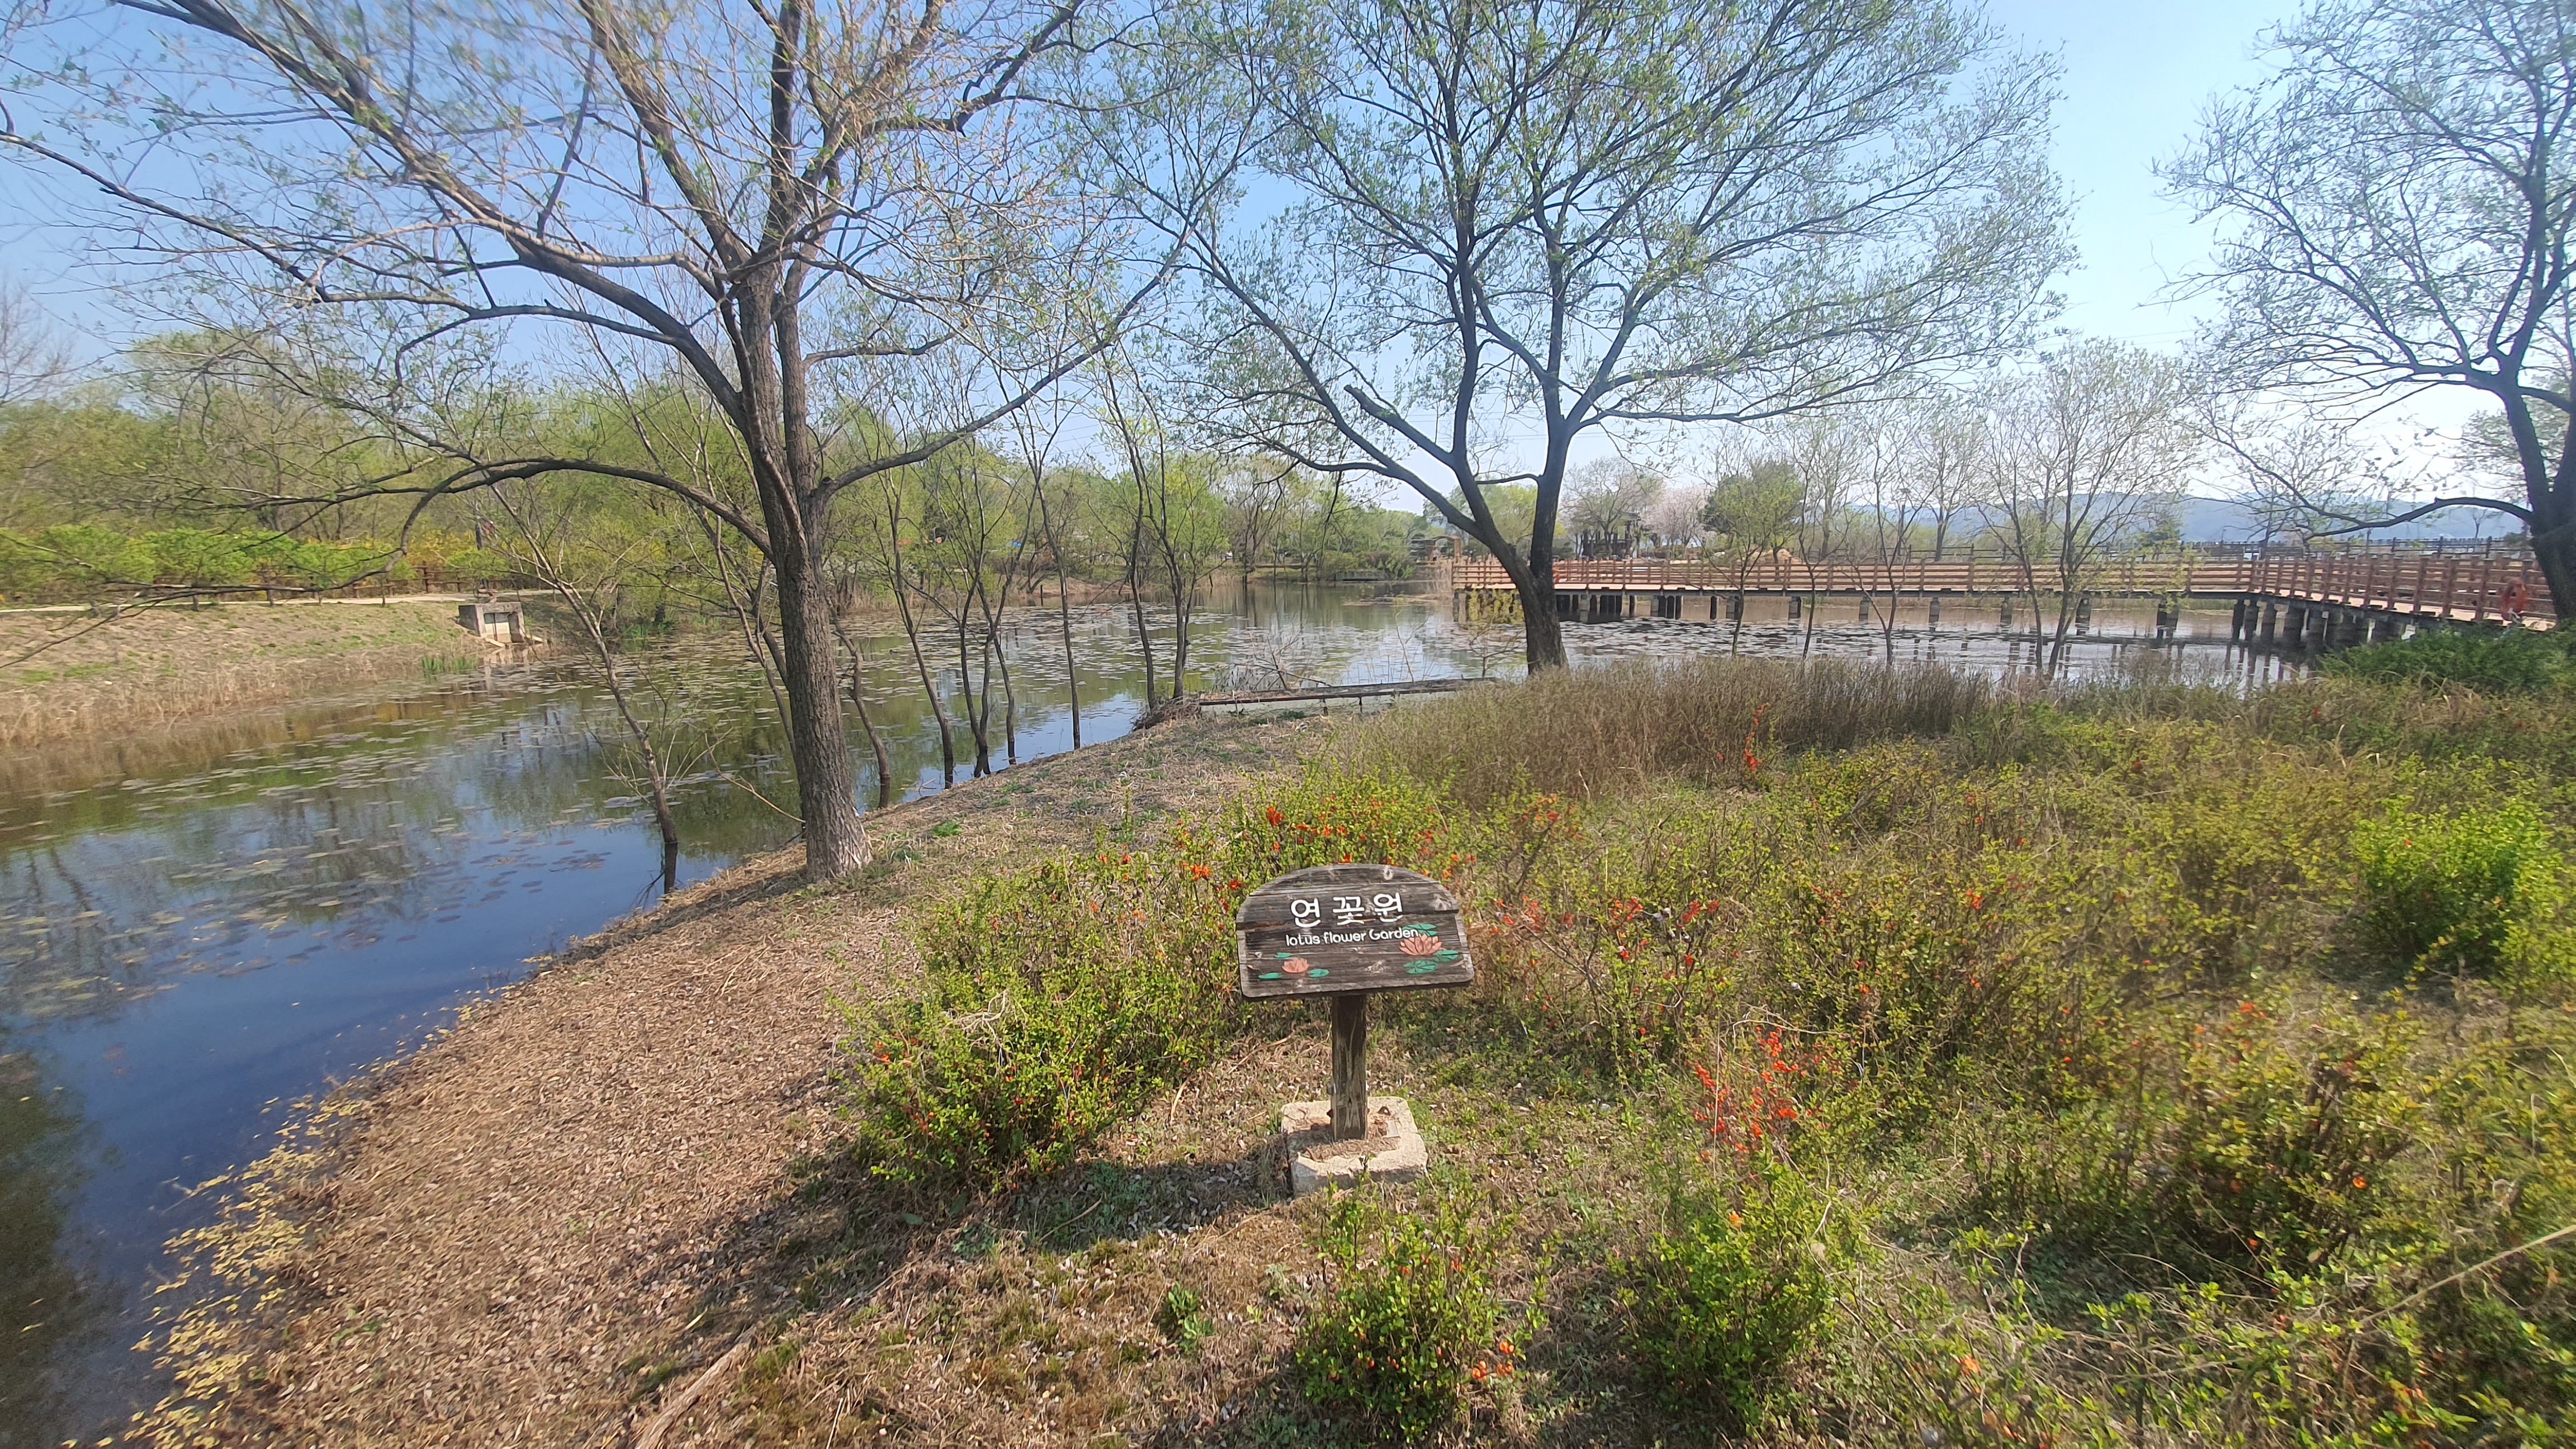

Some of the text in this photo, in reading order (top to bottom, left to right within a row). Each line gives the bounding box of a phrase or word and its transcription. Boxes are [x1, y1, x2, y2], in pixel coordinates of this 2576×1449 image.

[1286, 927, 1419, 946] lotus flower Garden
